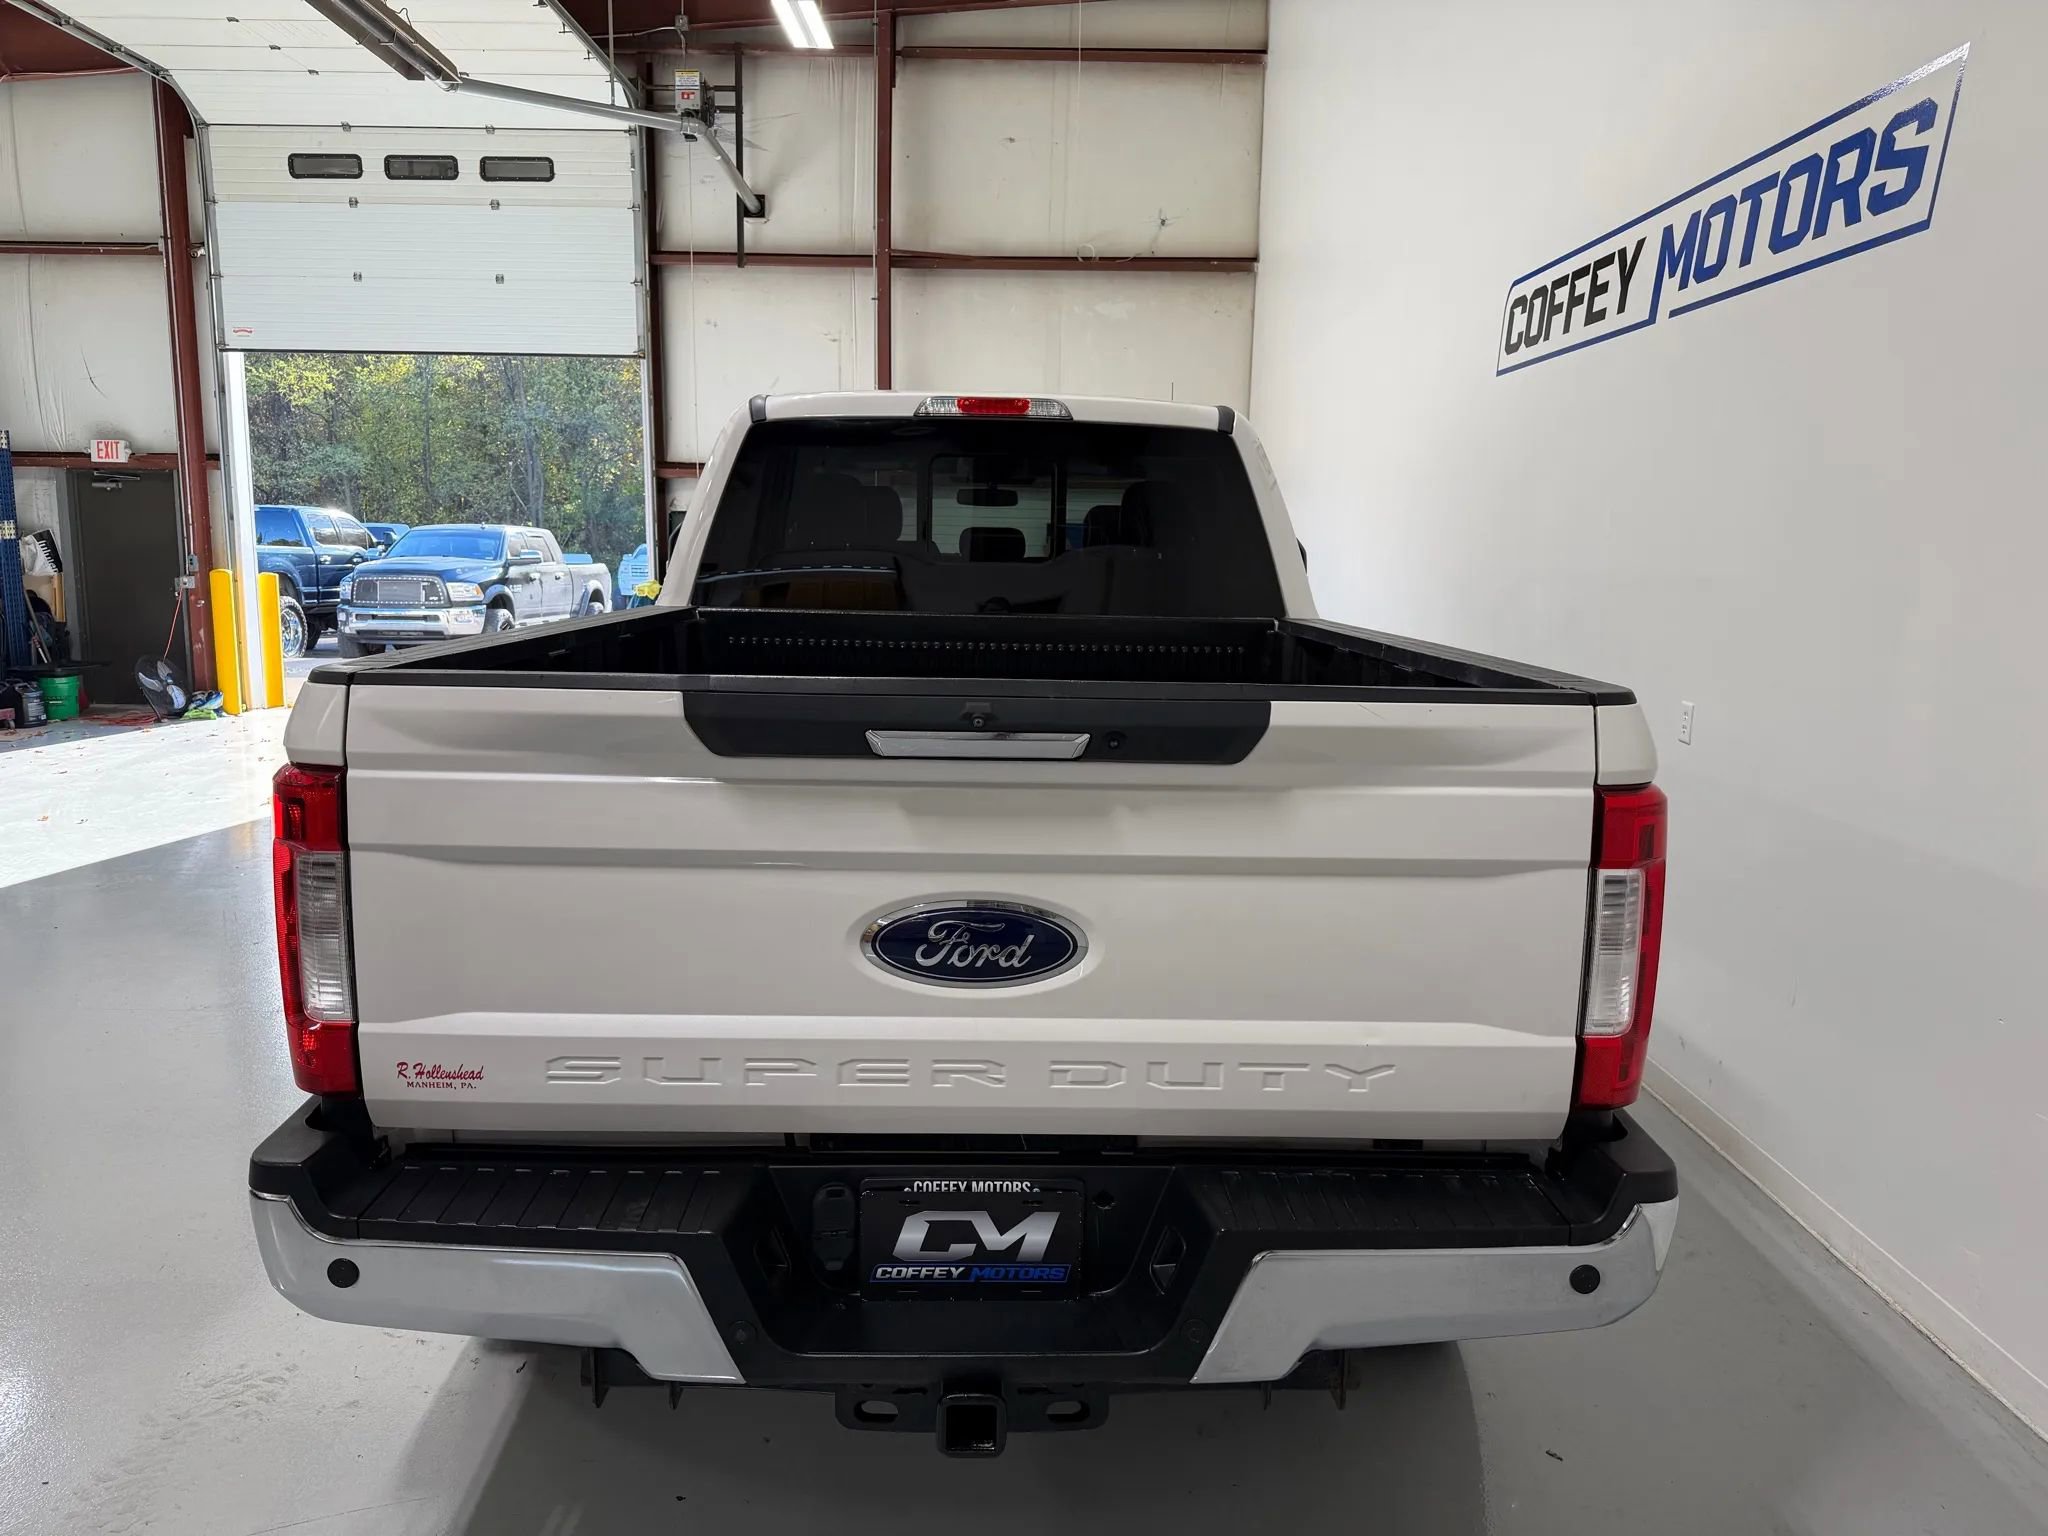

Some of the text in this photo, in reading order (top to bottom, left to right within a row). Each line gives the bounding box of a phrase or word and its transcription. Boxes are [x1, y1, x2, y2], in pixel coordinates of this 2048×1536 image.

[1504, 97, 1938, 356] COFFEY MOTORS
[96, 440, 120, 460] EXIT
[915, 920, 1035, 968] Ford
[396, 1061, 484, 1081] R. Hollenshead
[545, 1055, 1397, 1092] SUPER DUTY
[407, 1081, 477, 1090] MANHEIM, PA.
[913, 1180, 1031, 1193] COFFEY MOTORS
[892, 1210, 1061, 1262] CM
[875, 1266, 1066, 1281] COFFEY MOTORS
